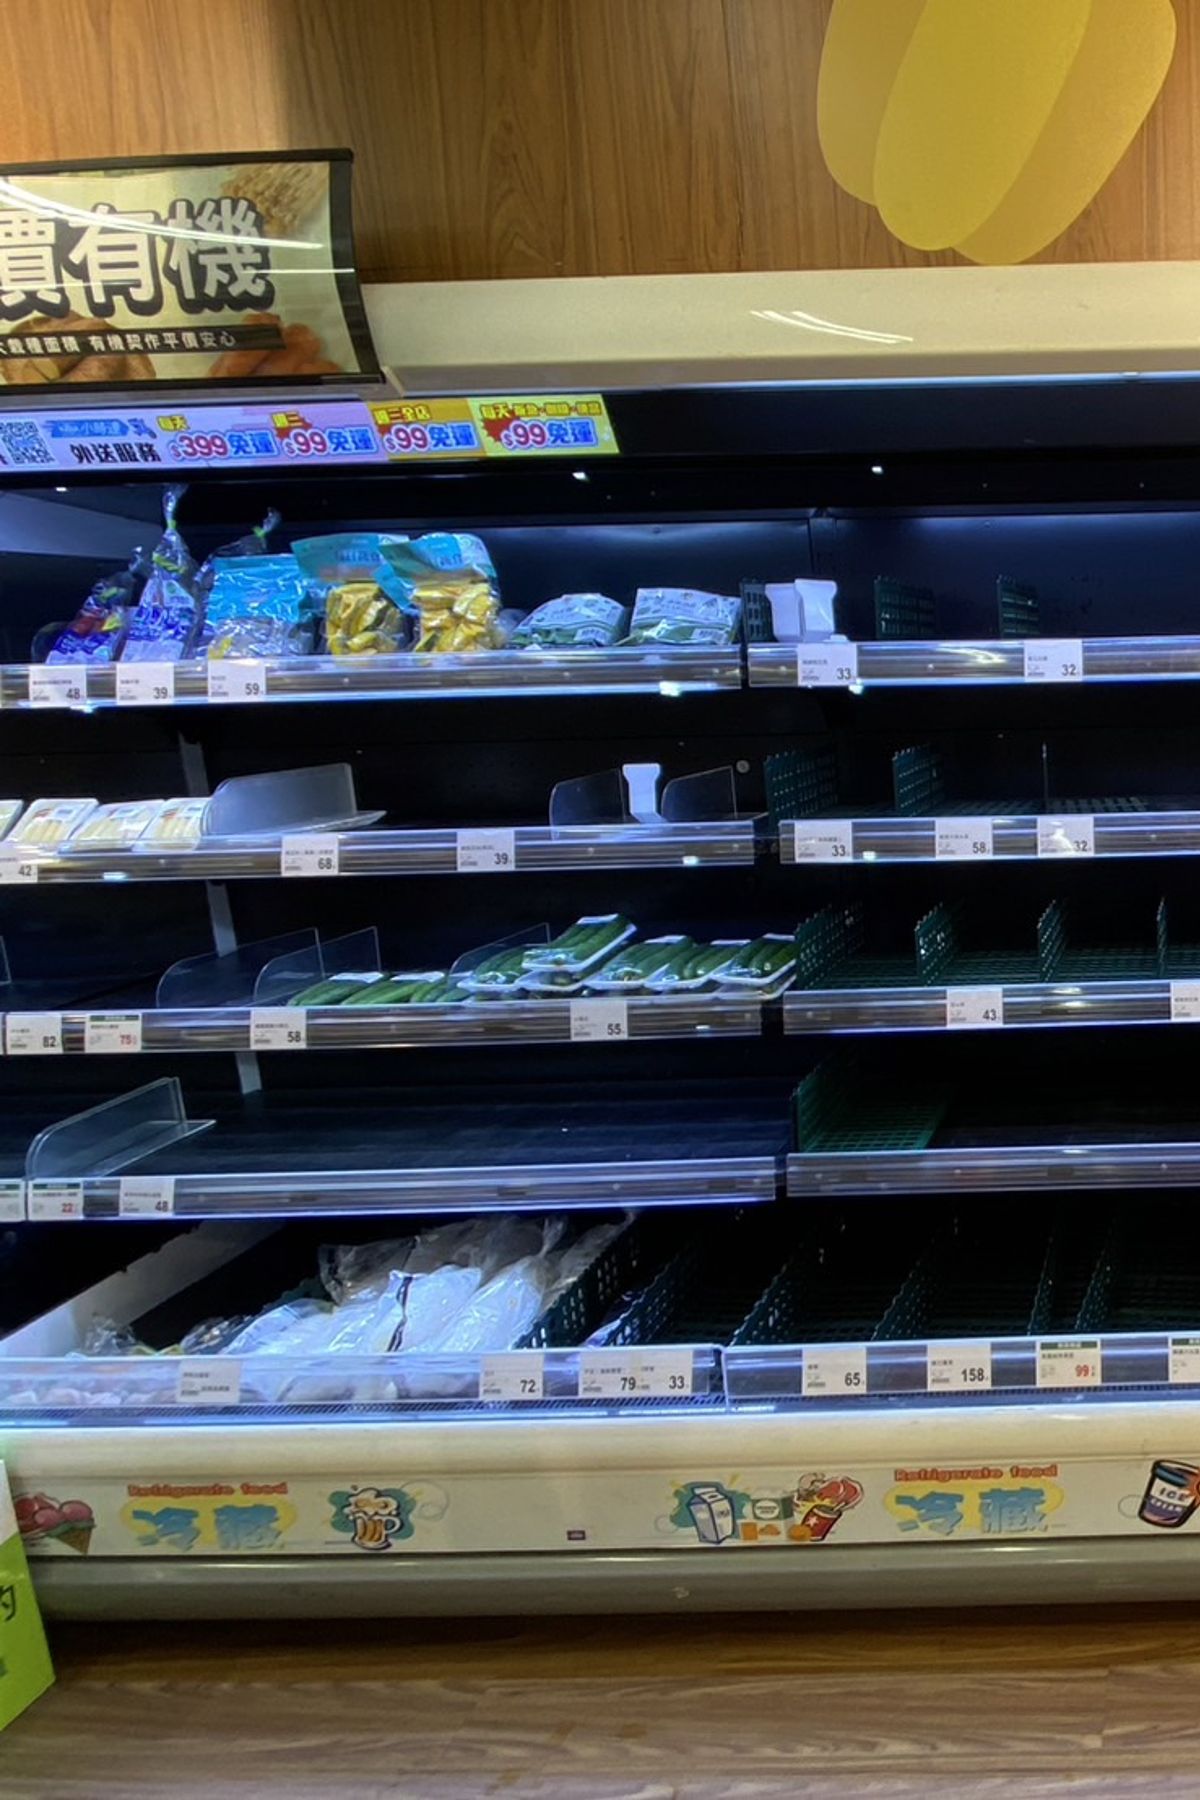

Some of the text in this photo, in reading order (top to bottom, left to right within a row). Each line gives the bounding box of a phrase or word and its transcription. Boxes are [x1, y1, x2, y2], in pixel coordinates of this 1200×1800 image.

[70, 442, 161, 464] 外送服務
[836, 668, 850, 680] 33
[1062, 664, 1076, 676] 32
[66, 688, 81, 700] 48
[153, 687, 168, 700] 39
[245, 683, 260, 696] 59
[831, 845, 846, 857] 33
[972, 842, 986, 854] 58
[1074, 840, 1088, 852] 32
[318, 858, 332, 870] 68
[494, 853, 508, 864] 39
[18, 865, 32, 876] 42
[982, 1009, 996, 1021] 43
[607, 1023, 622, 1035] 55
[288, 1031, 301, 1042] 58
[962, 1369, 984, 1382] 158
[1076, 1365, 1090, 1377] 99
[620, 1378, 636, 1390] 79
[669, 1376, 684, 1389] 33
[845, 1372, 860, 1386] 65
[520, 1380, 535, 1392] 72
[1010, 1465, 1058, 1478] food
[895, 1486, 1049, 1536] 冷藏
